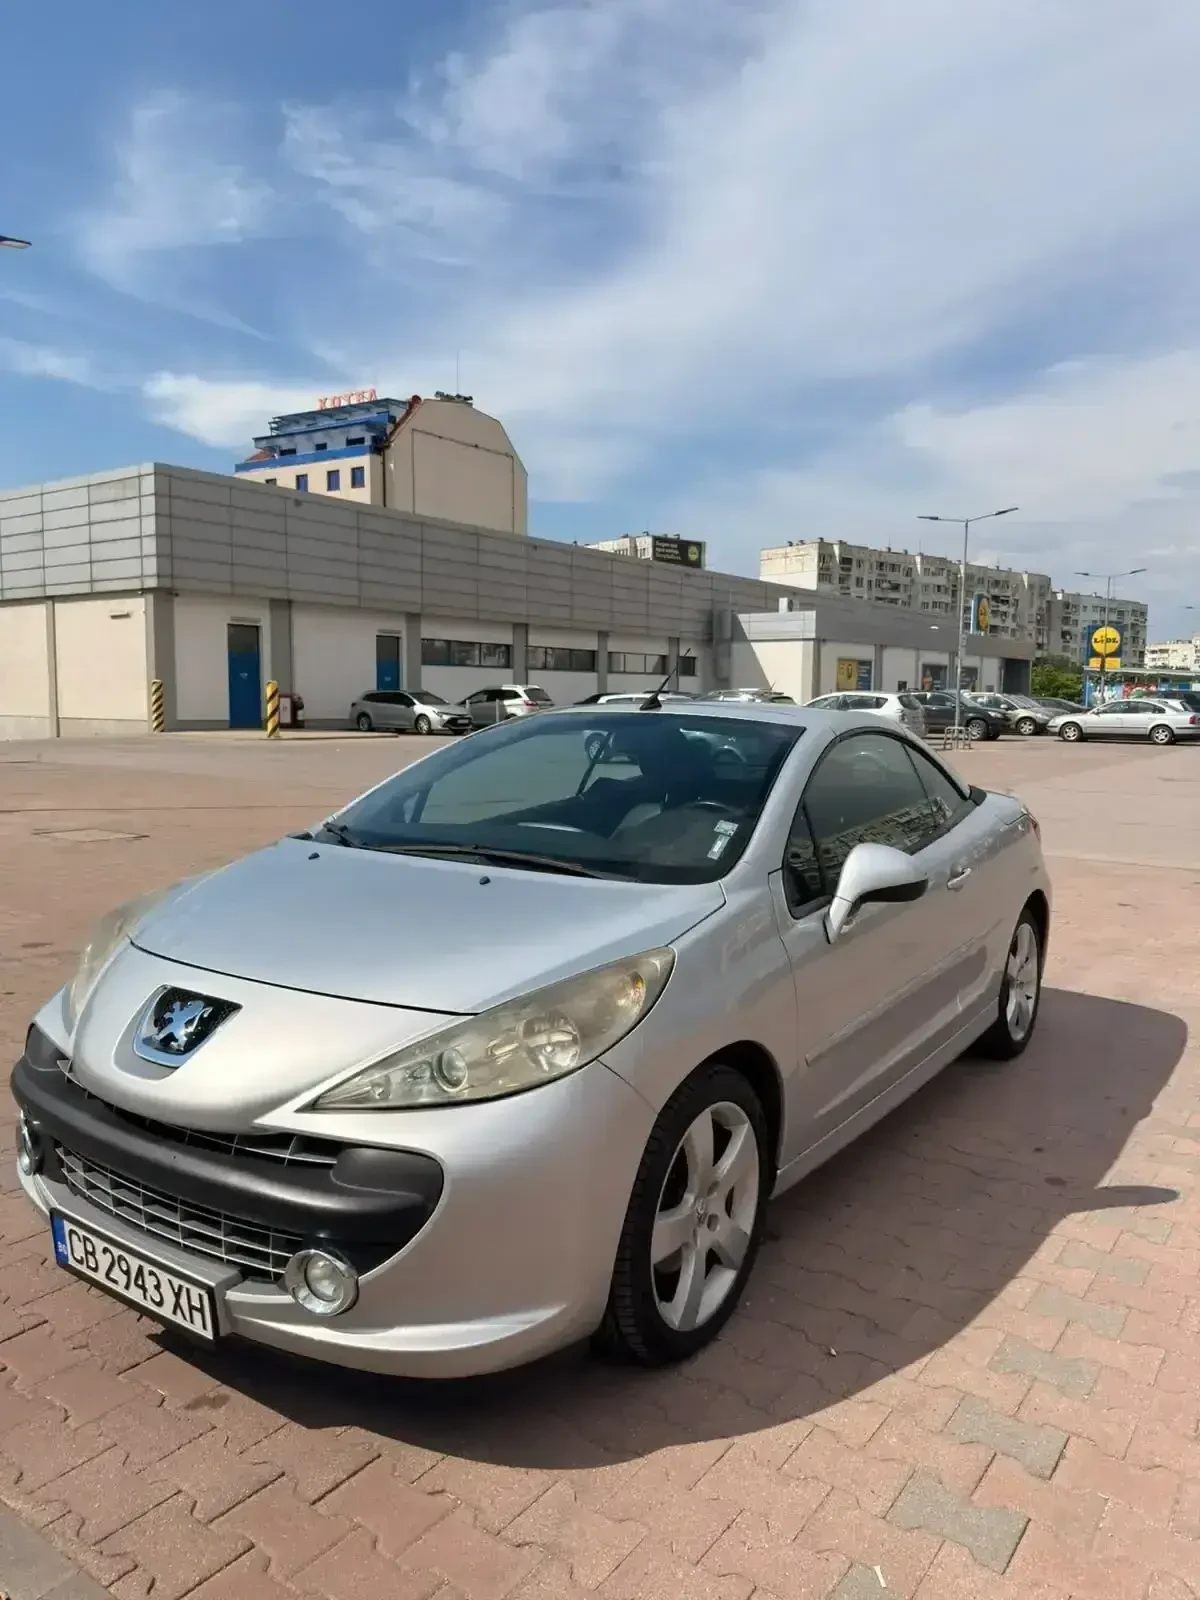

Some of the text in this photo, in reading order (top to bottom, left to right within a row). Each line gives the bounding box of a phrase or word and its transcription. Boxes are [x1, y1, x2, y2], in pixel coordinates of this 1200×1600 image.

[68, 1227, 209, 1332] CB 2943 XH
